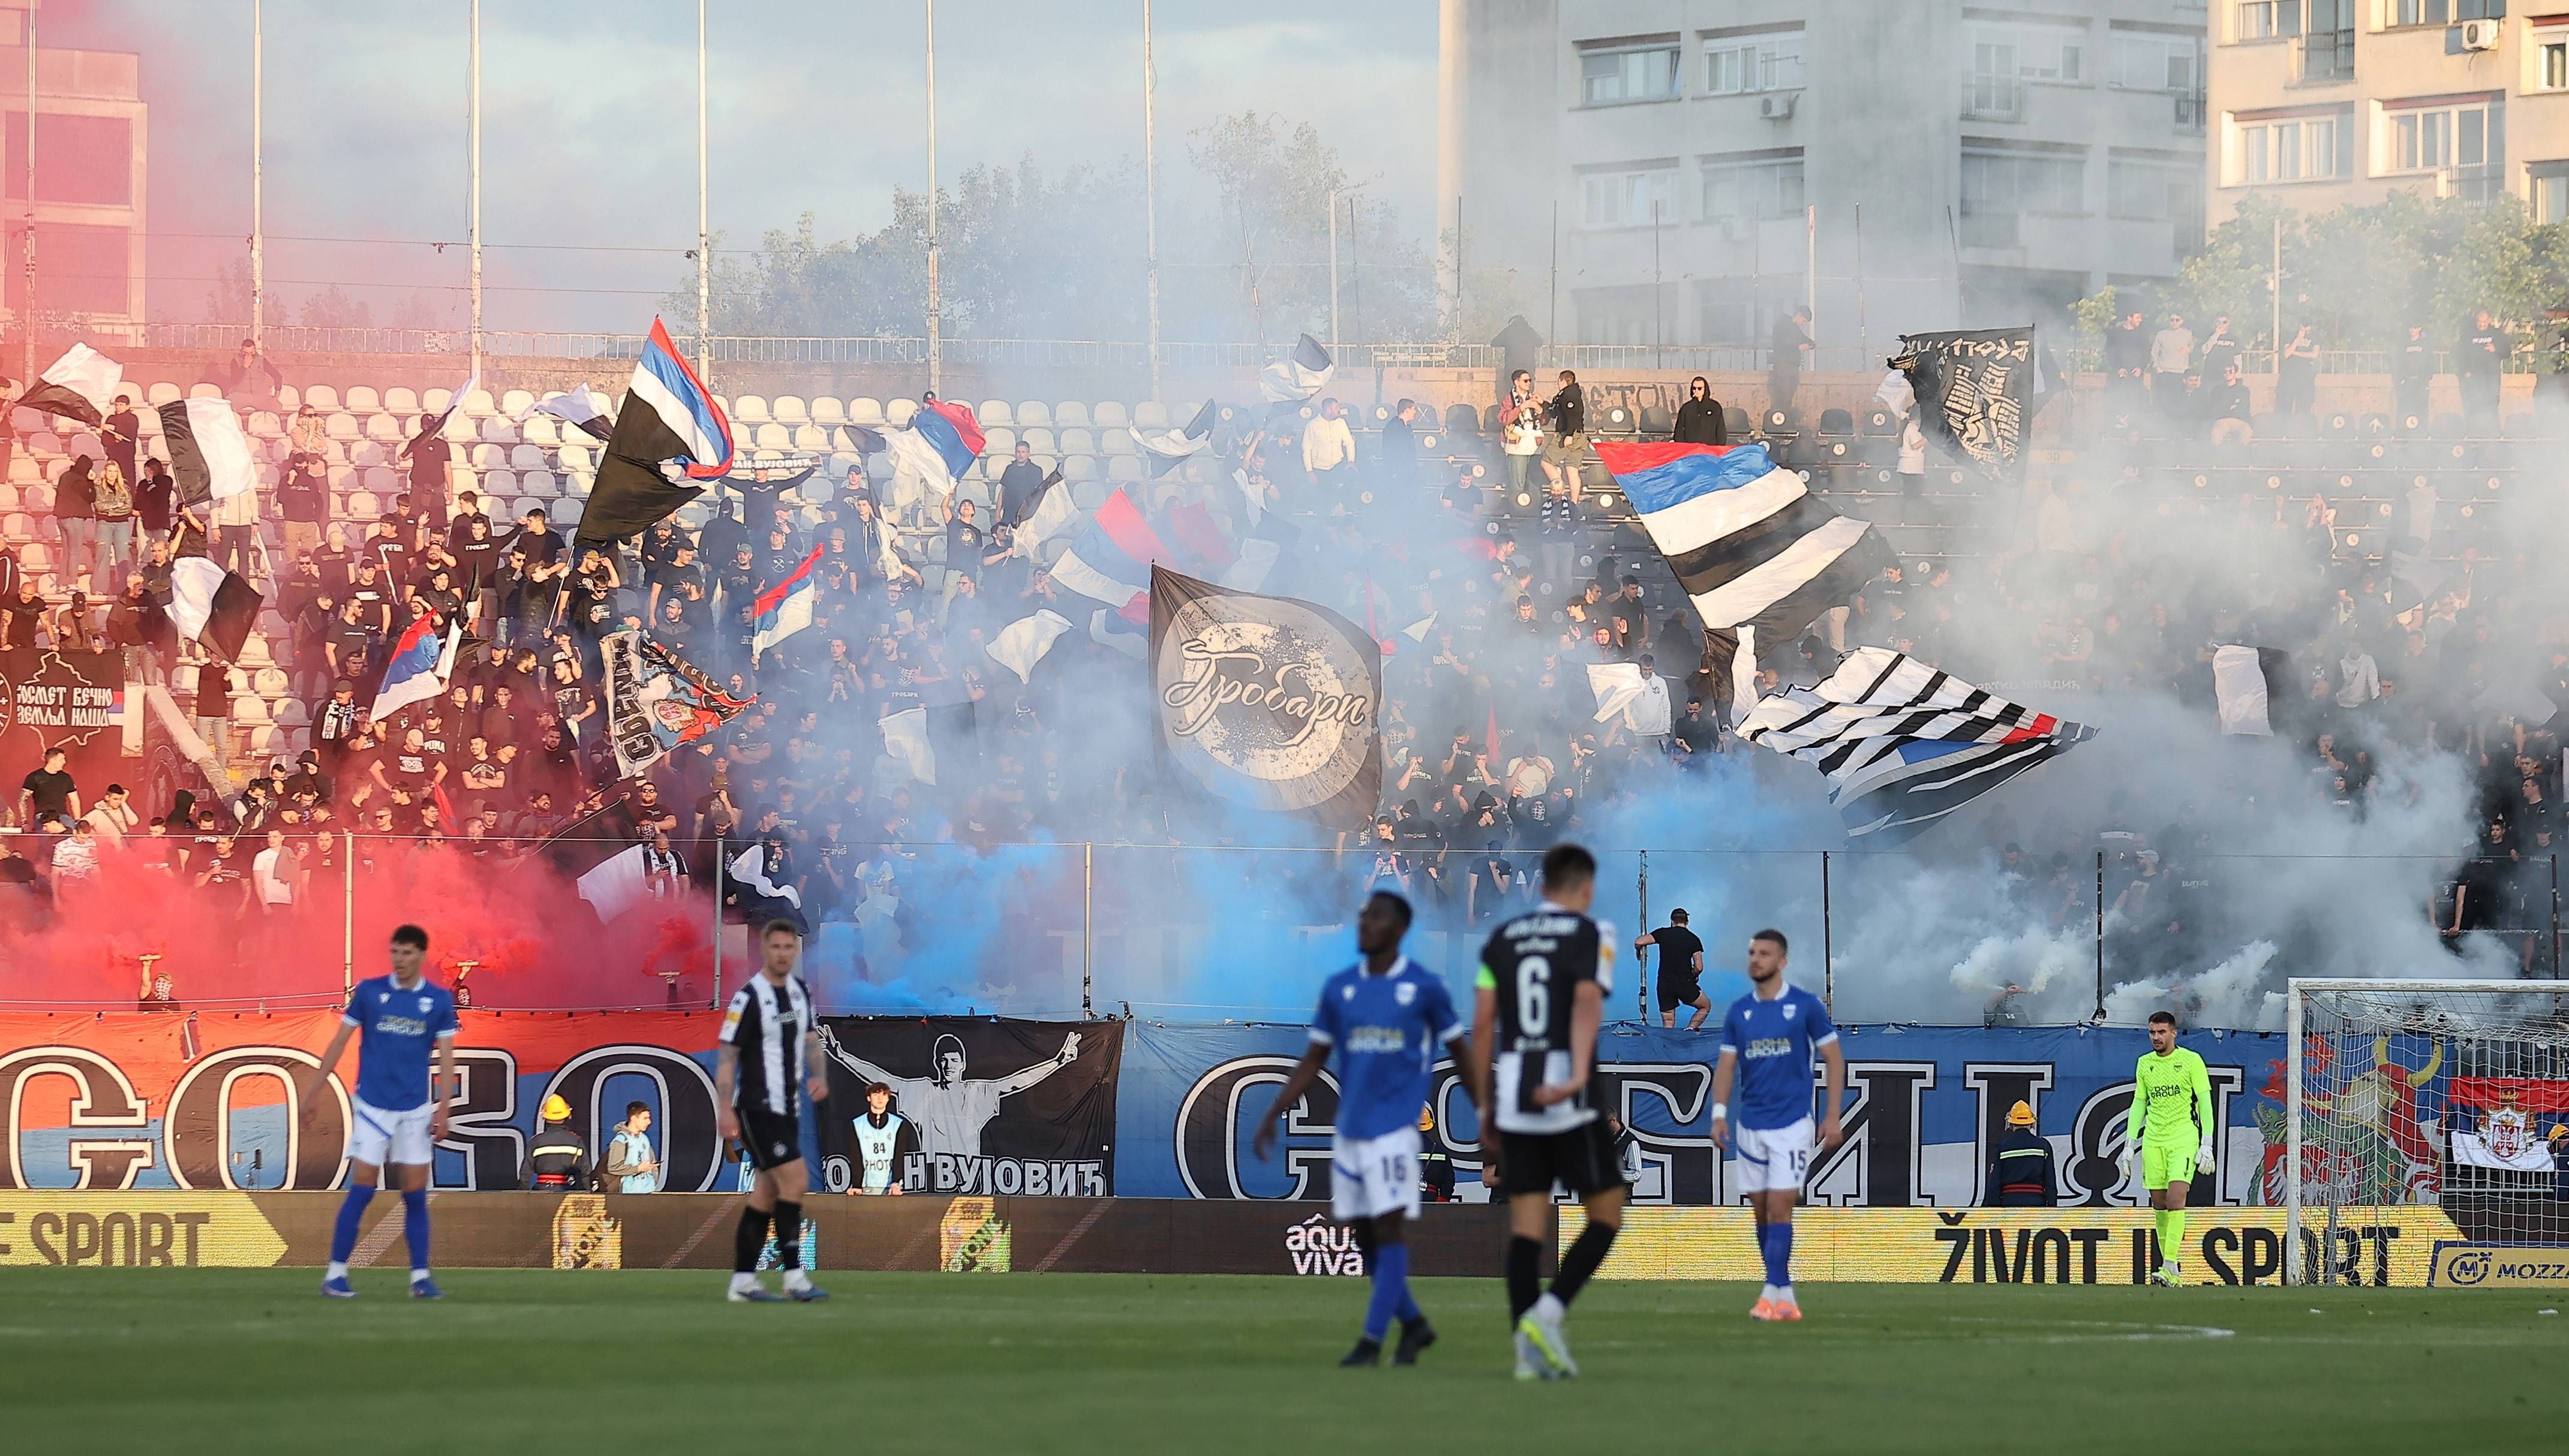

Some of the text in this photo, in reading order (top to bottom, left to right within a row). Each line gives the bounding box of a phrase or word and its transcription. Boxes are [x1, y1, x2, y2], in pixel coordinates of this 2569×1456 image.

[73, 687, 113, 706] ВЕЧНО
[71, 708, 109, 727] НАША
[424, 739, 446, 753] PUMA
[1515, 954, 1551, 1039] 6
[1744, 1046, 1792, 1060] GROUP
[2150, 1090, 2181, 1099] GROUP
[873, 1142, 886, 1154] 84
[1381, 1154, 1407, 1183] 16
[1789, 1150, 1806, 1170] 15
[934, 1152, 1107, 1196] ВУЈОВИЋ
[31, 1211, 210, 1267] SPORT
[1935, 1212, 2108, 1284] ŽIVOT
[2203, 1226, 2400, 1286] SPORT
[1291, 1251, 1363, 1276] viva
[2497, 1264, 2569, 1279] MOZZ
